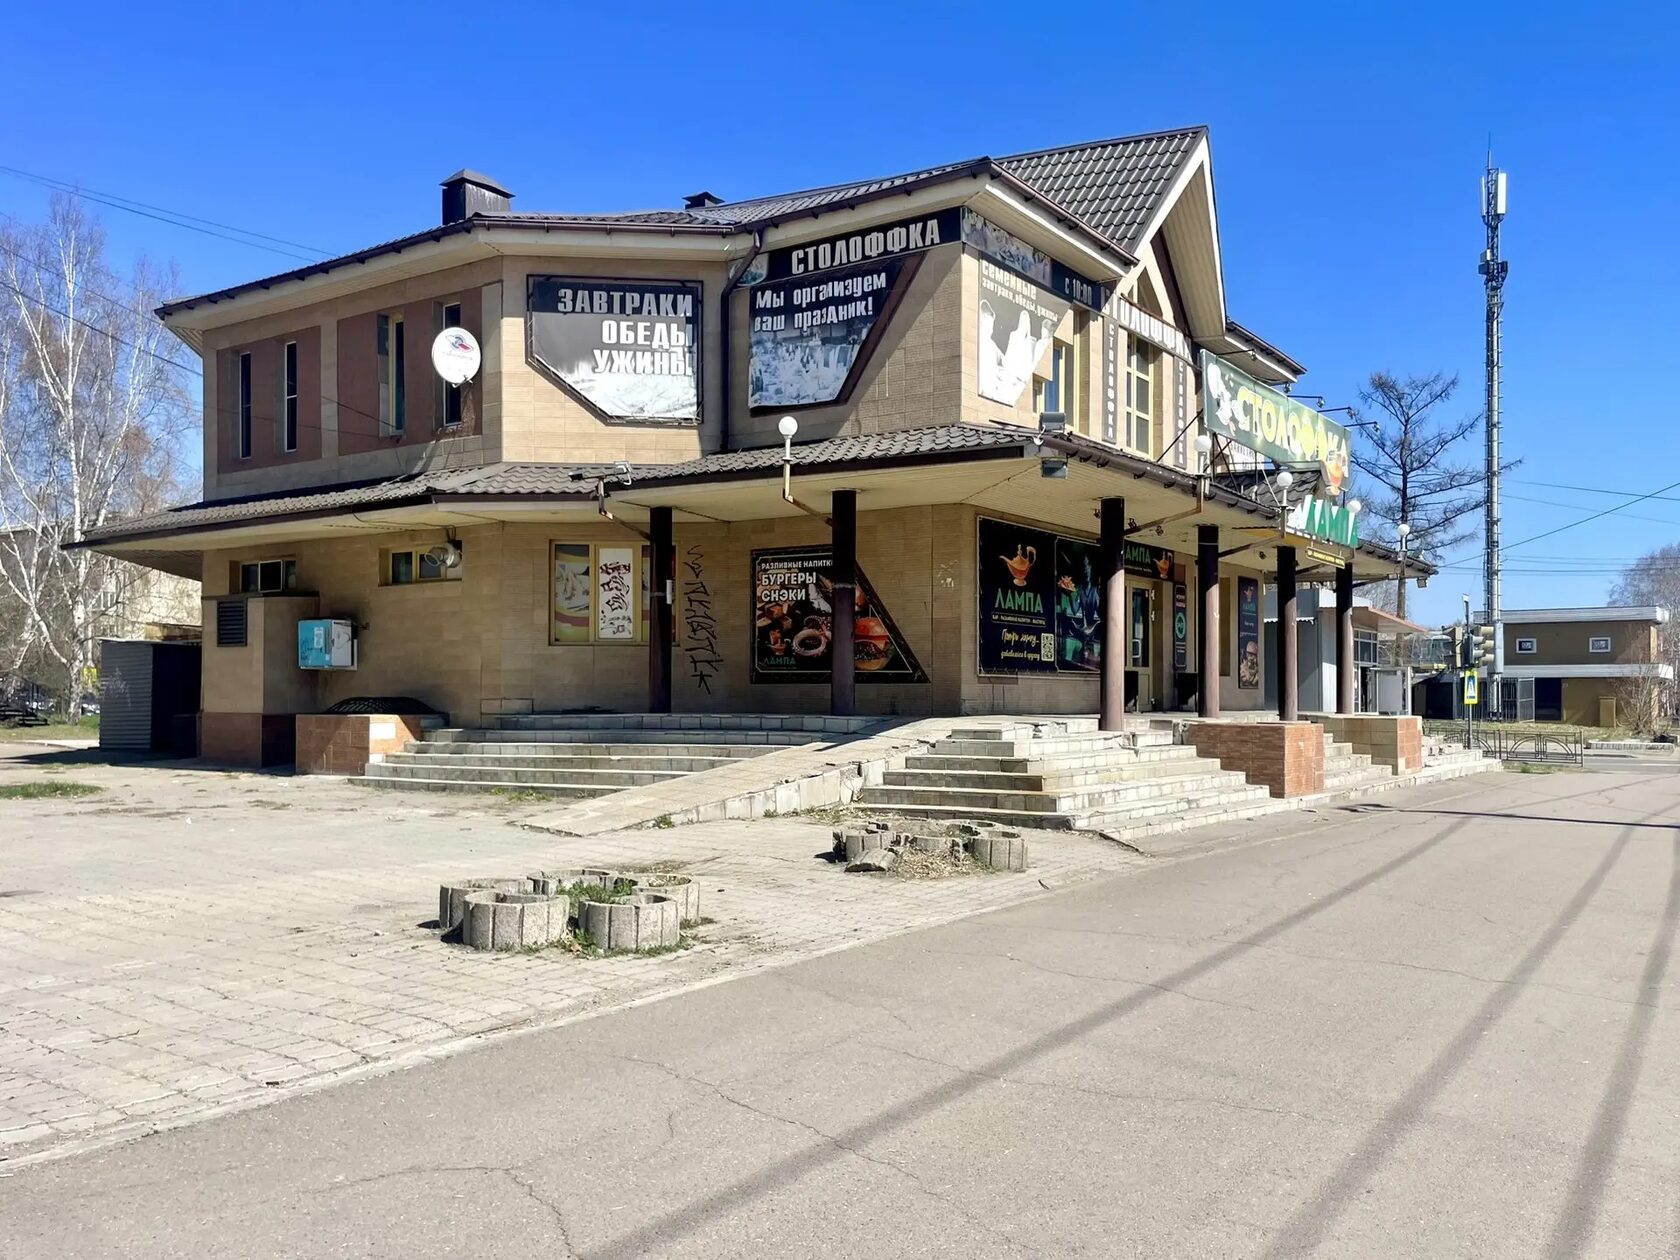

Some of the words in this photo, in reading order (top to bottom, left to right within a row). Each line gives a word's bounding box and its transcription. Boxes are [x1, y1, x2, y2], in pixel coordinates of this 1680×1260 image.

[791, 219, 941, 275] СТОЛОФФКА
[557, 288, 693, 317] ЗАВТРАКИ
[756, 290, 785, 309] Мы
[754, 315, 785, 333] ваш
[602, 320, 693, 350] ОБЕДЫ
[593, 349, 693, 376] УЖИНЫ
[803, 559, 833, 568] НАПИТК
[1125, 544, 1152, 565] АМПА
[761, 571, 817, 586] БУРГЕРЫ
[761, 588, 806, 602] СНЭКИ
[994, 587, 1044, 614] ЛАМПА
[764, 655, 797, 665] ЛАМПА
